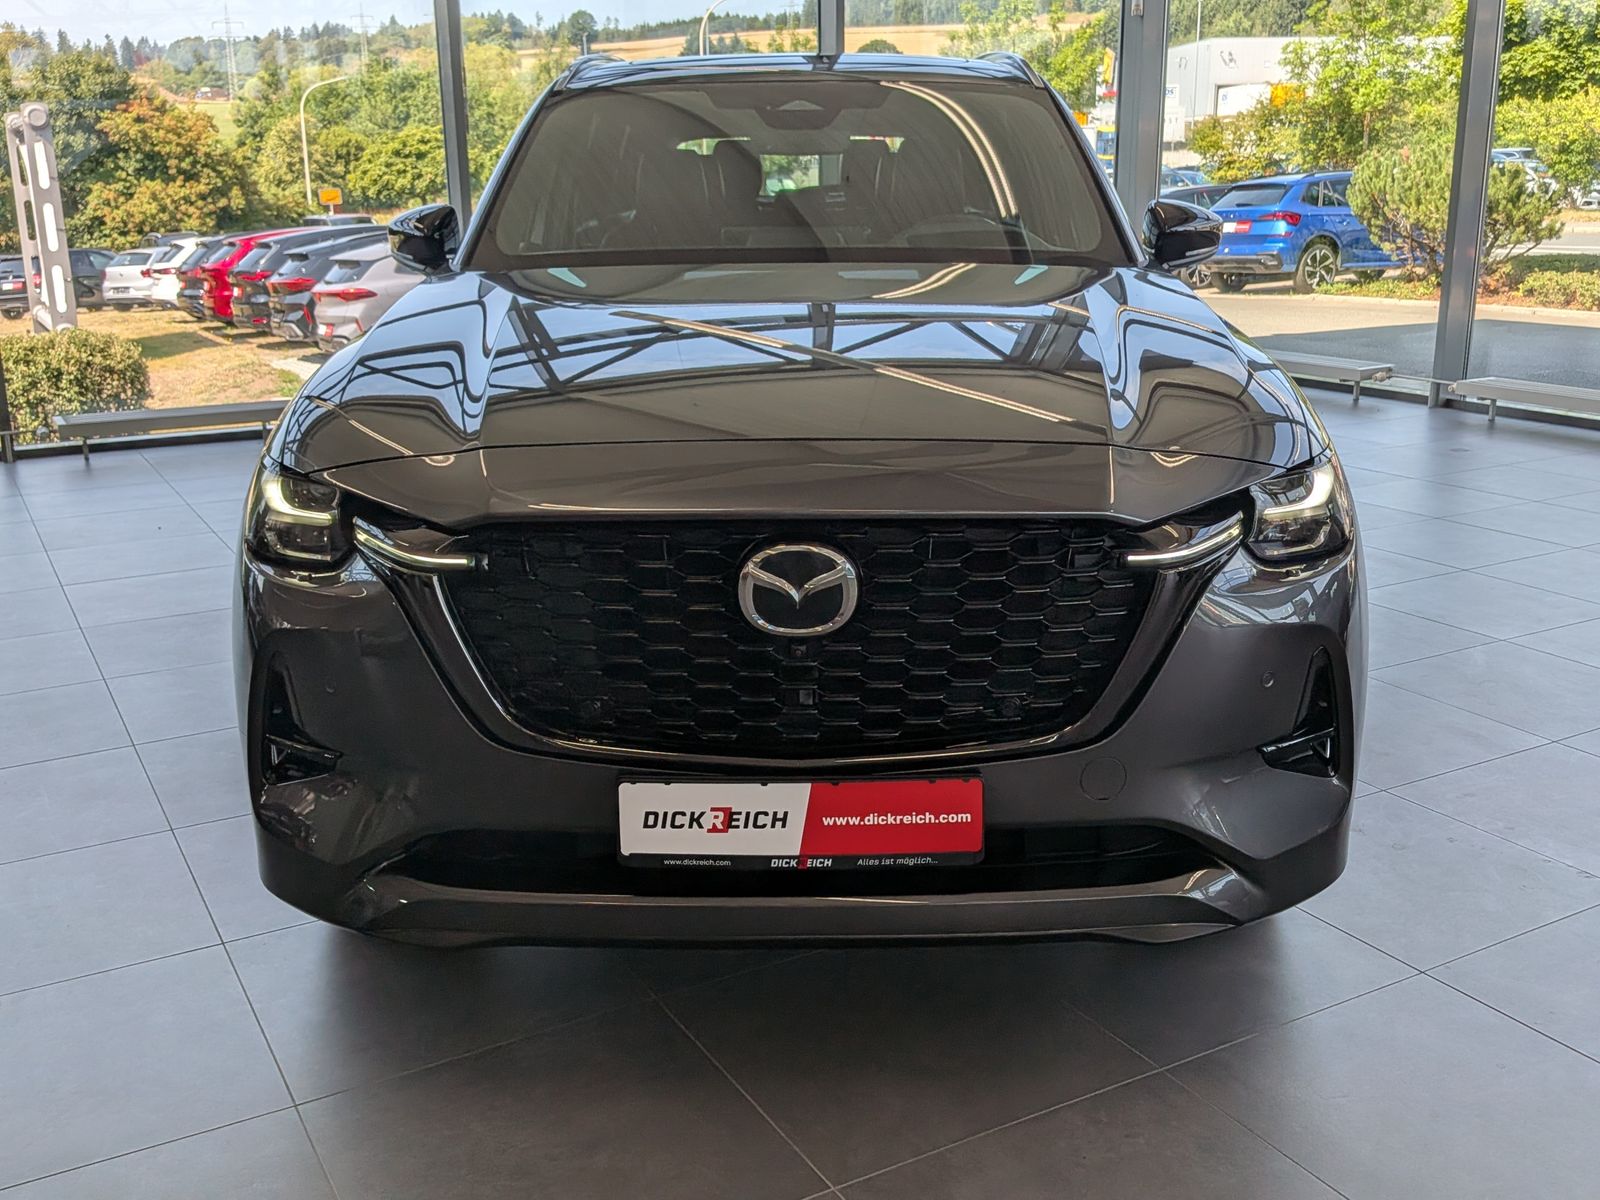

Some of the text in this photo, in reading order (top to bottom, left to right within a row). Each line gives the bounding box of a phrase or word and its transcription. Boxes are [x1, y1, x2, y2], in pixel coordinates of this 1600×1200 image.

[642, 807, 789, 833] DICKREICH
[822, 812, 972, 826] www.dickreich.com
[663, 858, 732, 867] www.dickreich.com
[770, 858, 833, 869] DICKEICH
[857, 858, 880, 866] Alles
[881, 857, 894, 865] ist
